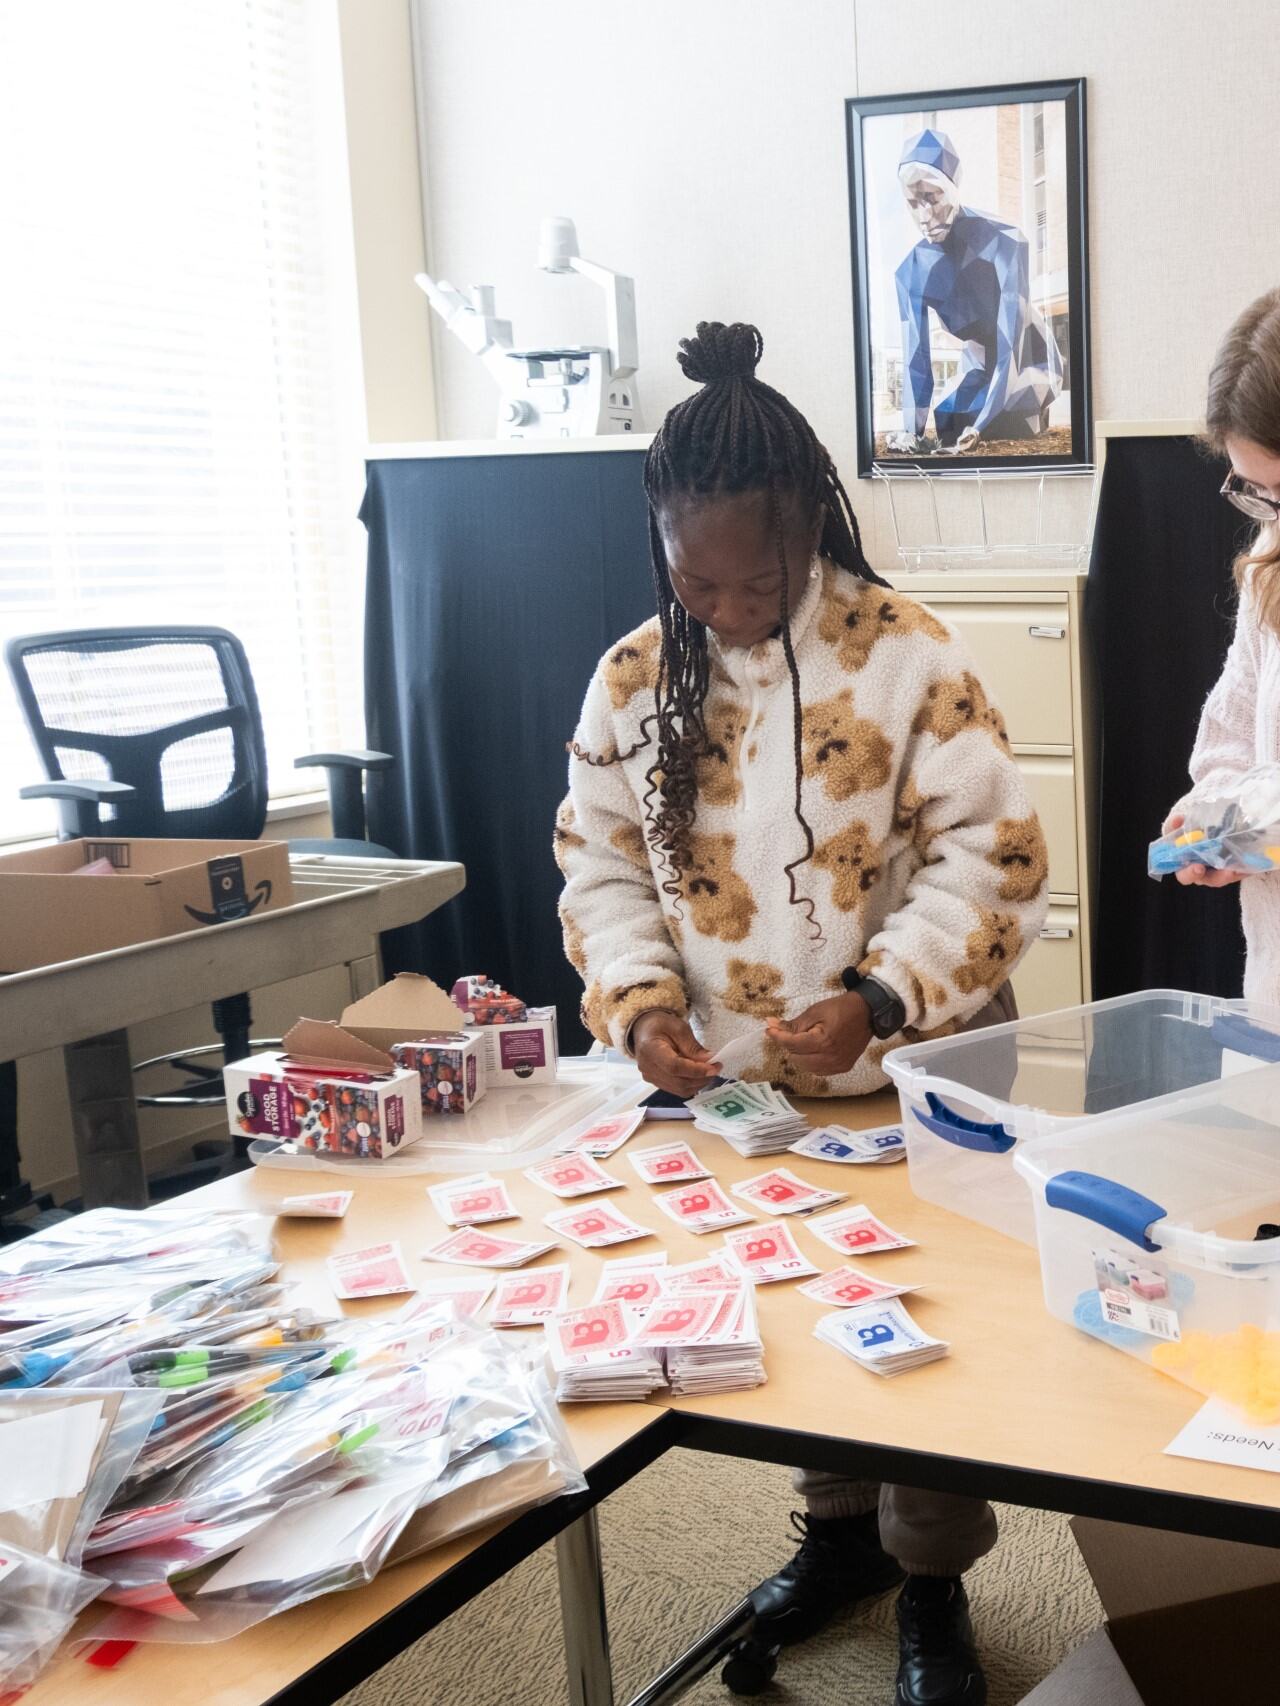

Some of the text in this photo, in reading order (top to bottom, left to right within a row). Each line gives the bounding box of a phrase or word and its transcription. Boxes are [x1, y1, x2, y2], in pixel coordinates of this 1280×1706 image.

[263, 1093, 272, 1122] FOOD
[269, 1085, 280, 1132] STORAGE
[1205, 1431, 1275, 1451] Needs:
